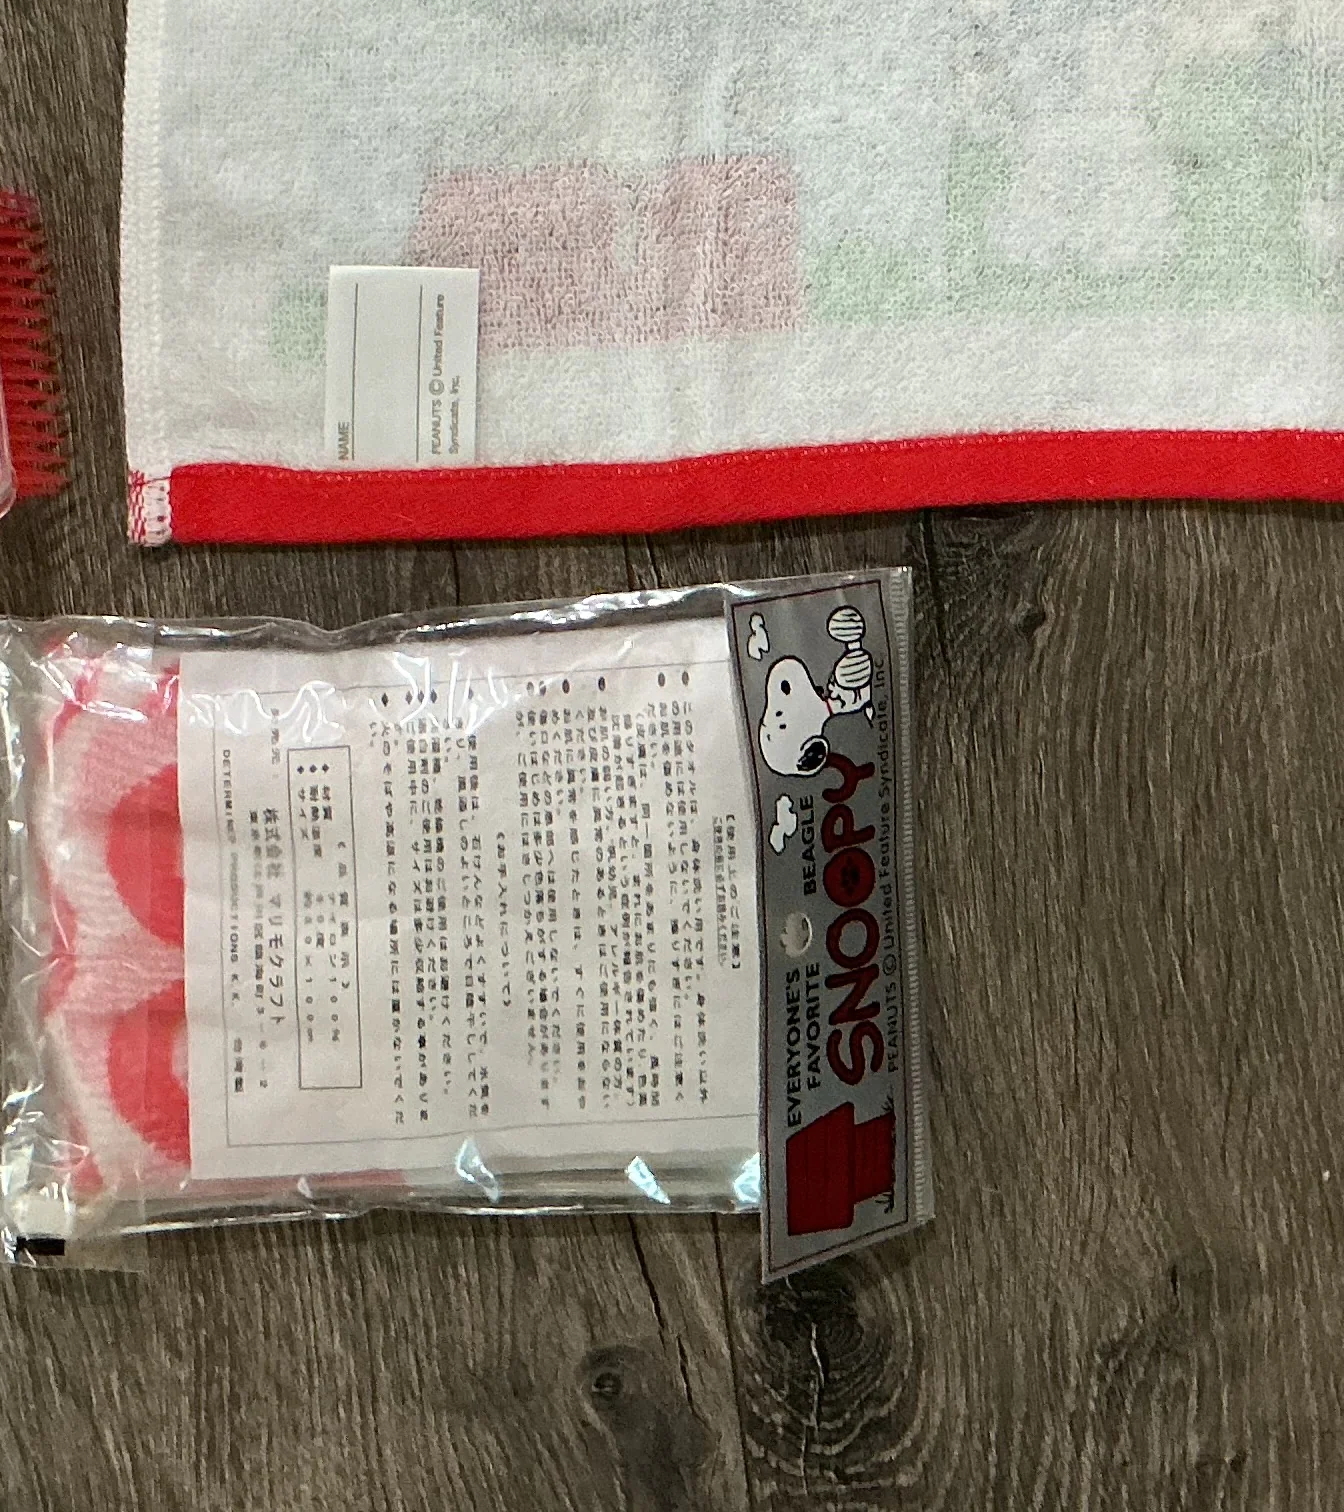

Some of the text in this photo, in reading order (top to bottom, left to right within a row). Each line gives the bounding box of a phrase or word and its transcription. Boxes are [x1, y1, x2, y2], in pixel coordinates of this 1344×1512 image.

[434, 294, 445, 337] Feature
[432, 340, 443, 377] United
[337, 421, 350, 461] NAME
[431, 399, 442, 455] PEANUTS
[878, 801, 891, 878] Feature
[799, 795, 821, 1091] FAVORITE BEAGLE
[820, 751, 885, 1086] SNOOPY
[879, 884, 894, 950] United
[786, 968, 802, 1127] EVERYONE'S
[885, 981, 899, 1074] PEANUTS
